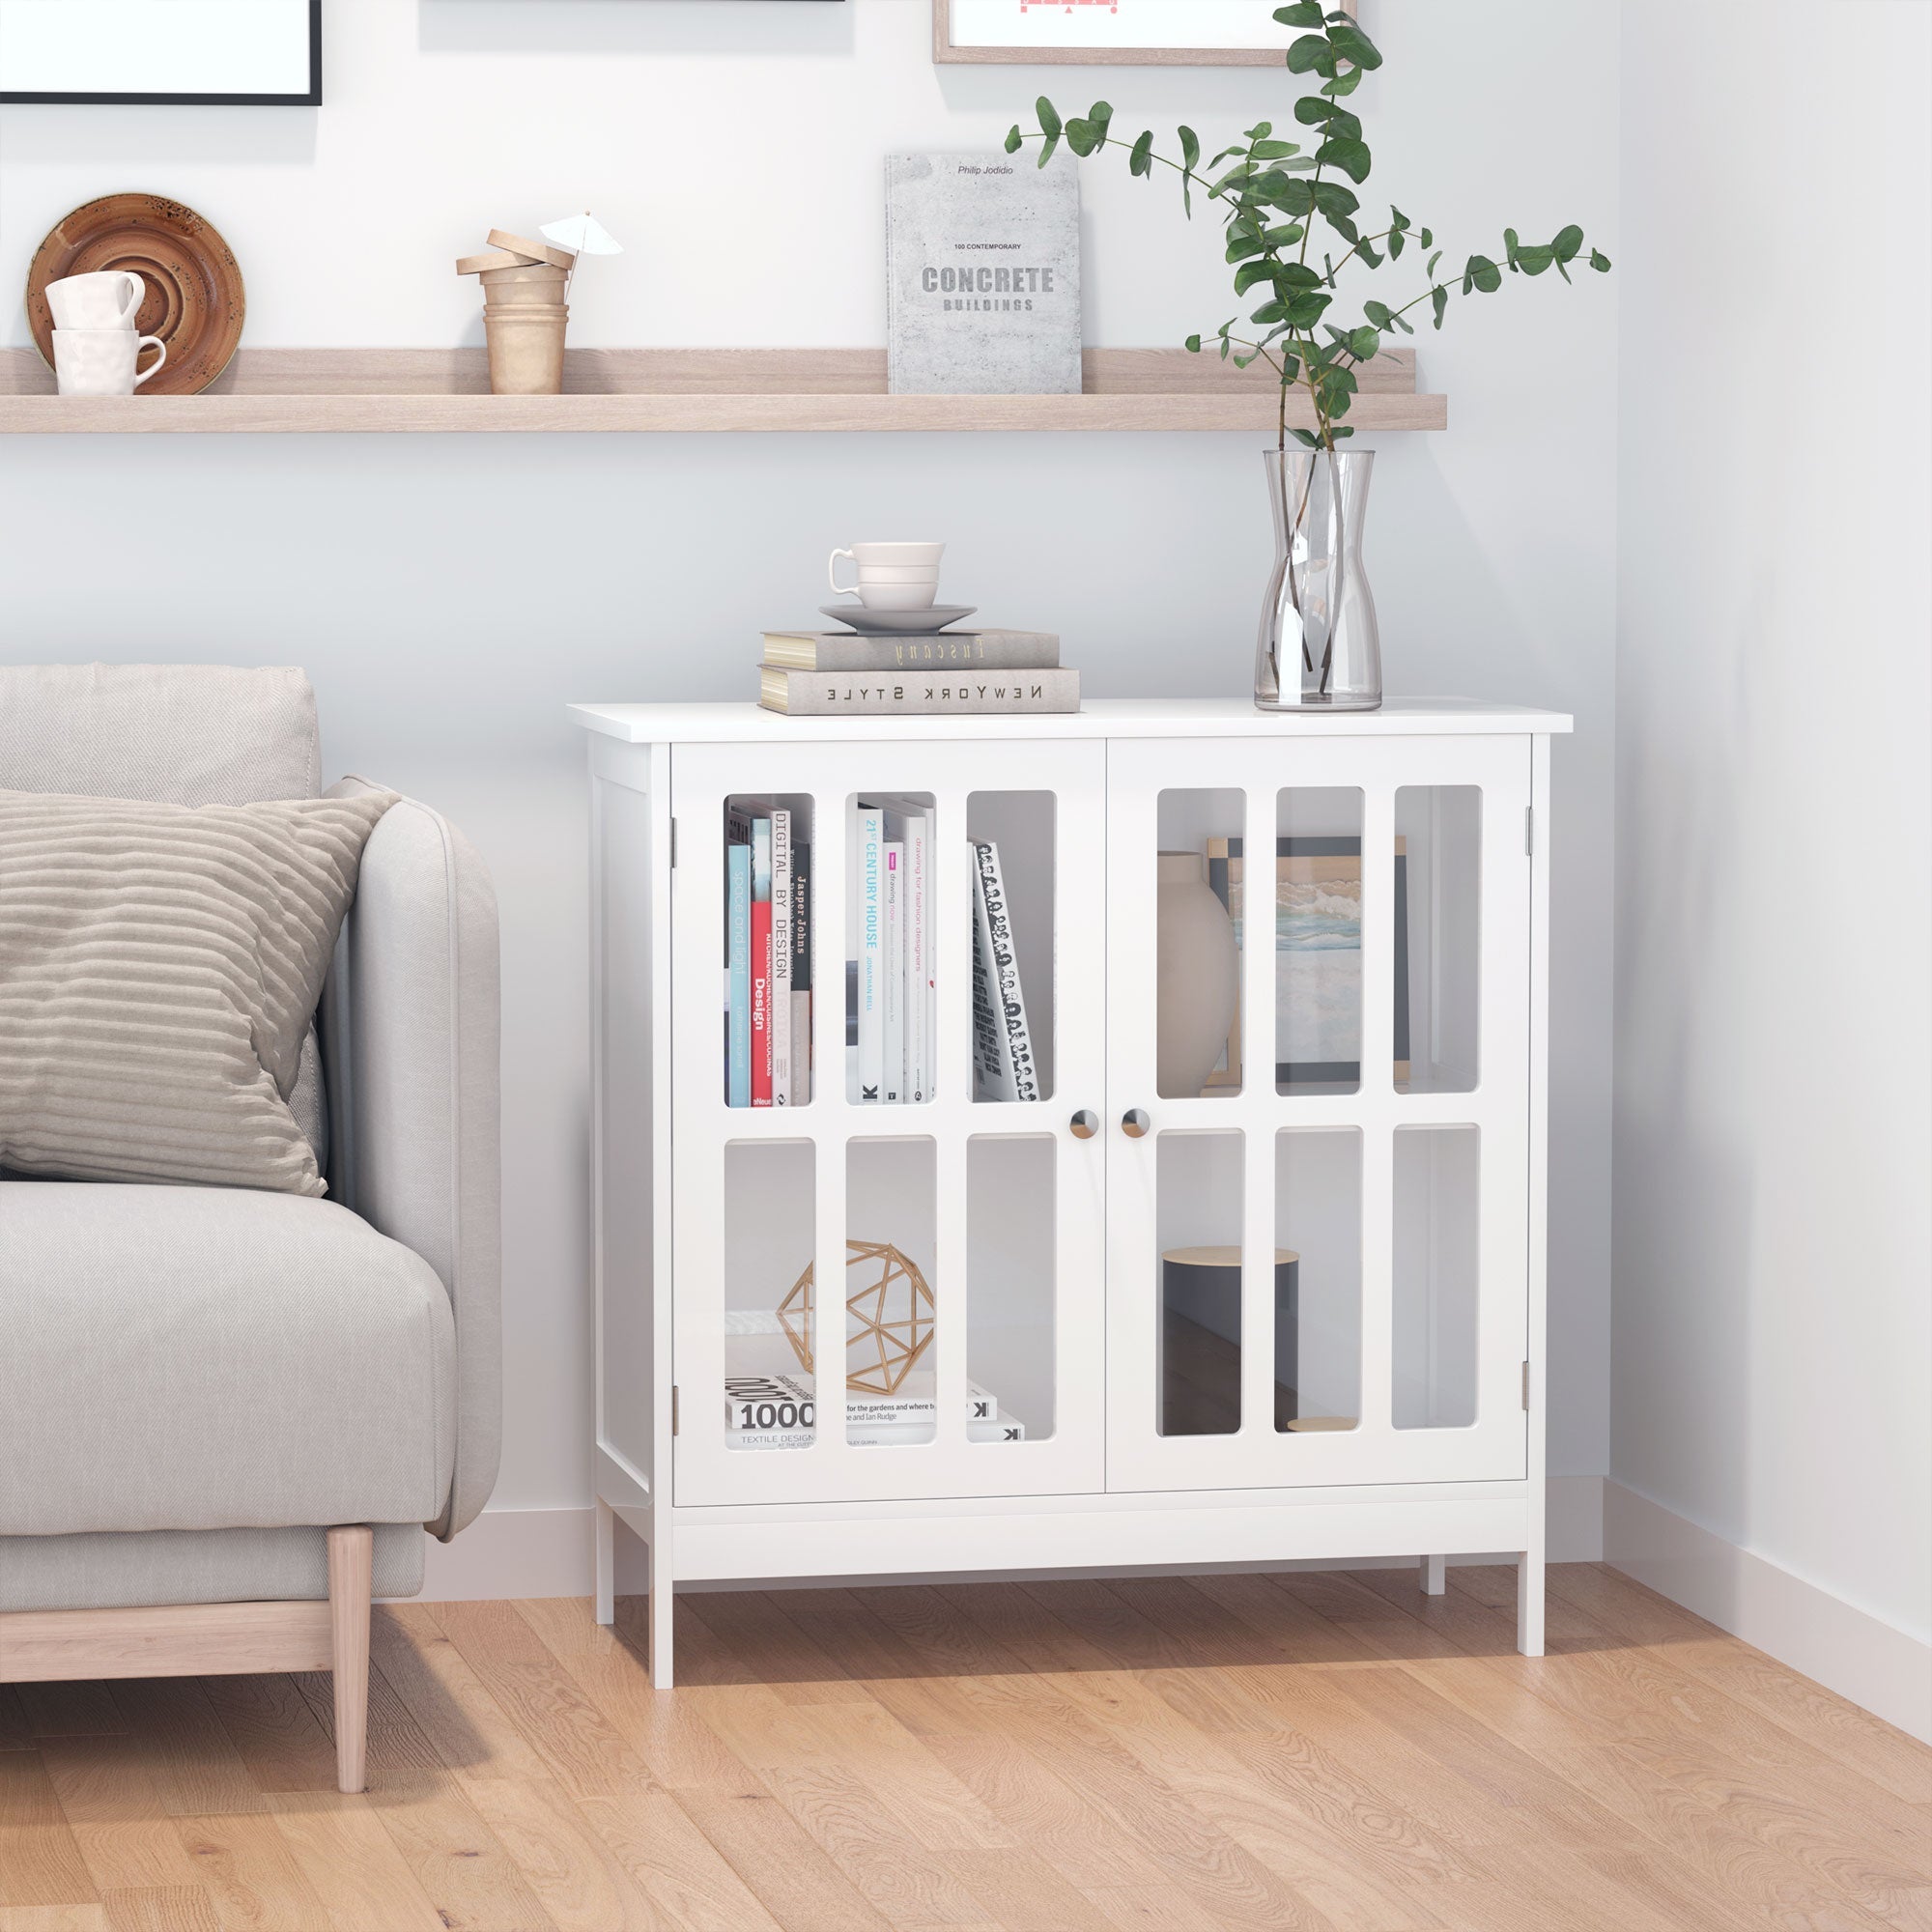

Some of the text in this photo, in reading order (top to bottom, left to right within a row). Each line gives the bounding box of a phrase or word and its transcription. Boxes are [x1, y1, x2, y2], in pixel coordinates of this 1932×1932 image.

[958, 165, 1013, 175] Philip Jodidio
[922, 268, 1054, 293] CONCRETE
[944, 299, 1033, 311] BUILDINGS
[866, 842, 877, 902] CENTURY
[888, 873, 896, 904] drawing
[776, 812, 786, 979] DIGITAL BY DESIGN
[732, 871, 747, 975] space and light
[797, 876, 806, 954] Jasper Johns
[866, 905, 877, 949] HOUSE
[753, 979, 766, 1031] Design
[741, 1403, 813, 1429] 1000
[869, 1404, 895, 1412] gardens
